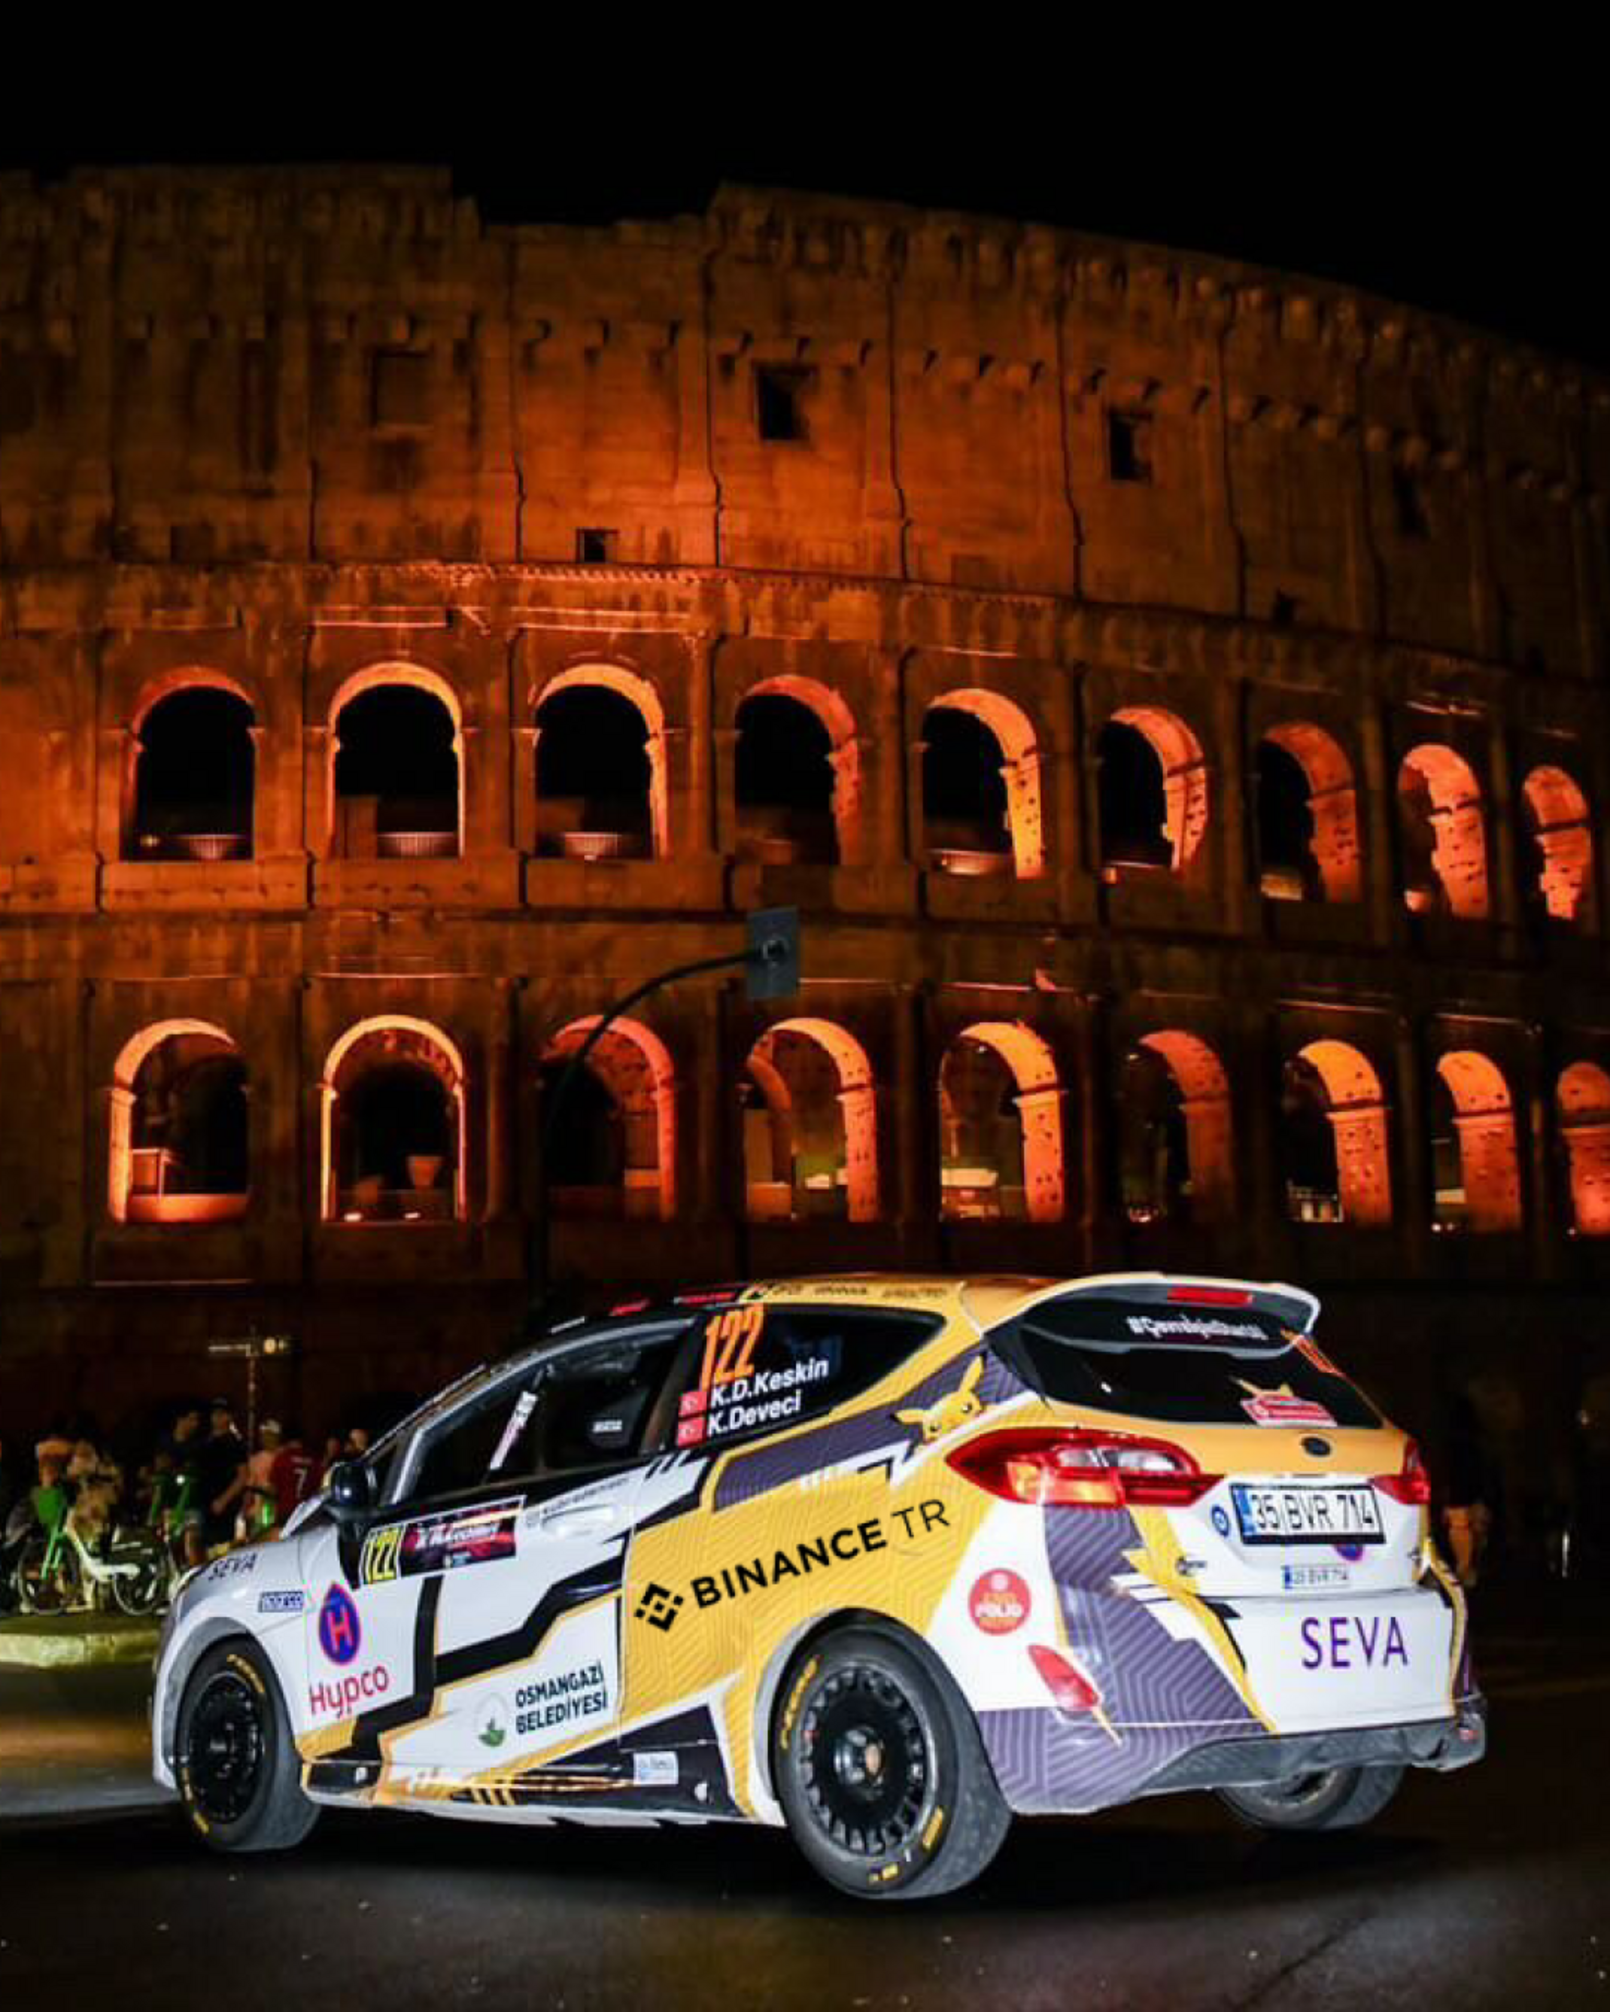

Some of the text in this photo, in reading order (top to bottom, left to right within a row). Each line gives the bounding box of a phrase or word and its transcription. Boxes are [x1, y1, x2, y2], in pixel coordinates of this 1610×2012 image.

[701, 1302, 764, 1392] 122
[710, 1357, 830, 1407] K.D.Keskin
[707, 1389, 802, 1437] K.Deveci
[1251, 1494, 1374, 1530] 35 BVR 714
[365, 1528, 398, 1584] 122
[690, 1499, 950, 1609] BINANCE TR
[1301, 1616, 1408, 1669] SEVA
[309, 1666, 390, 1719] Hypco
[515, 1659, 605, 1708] OSMANGAZİ
[515, 1685, 608, 1734] BELEDİYESİ
